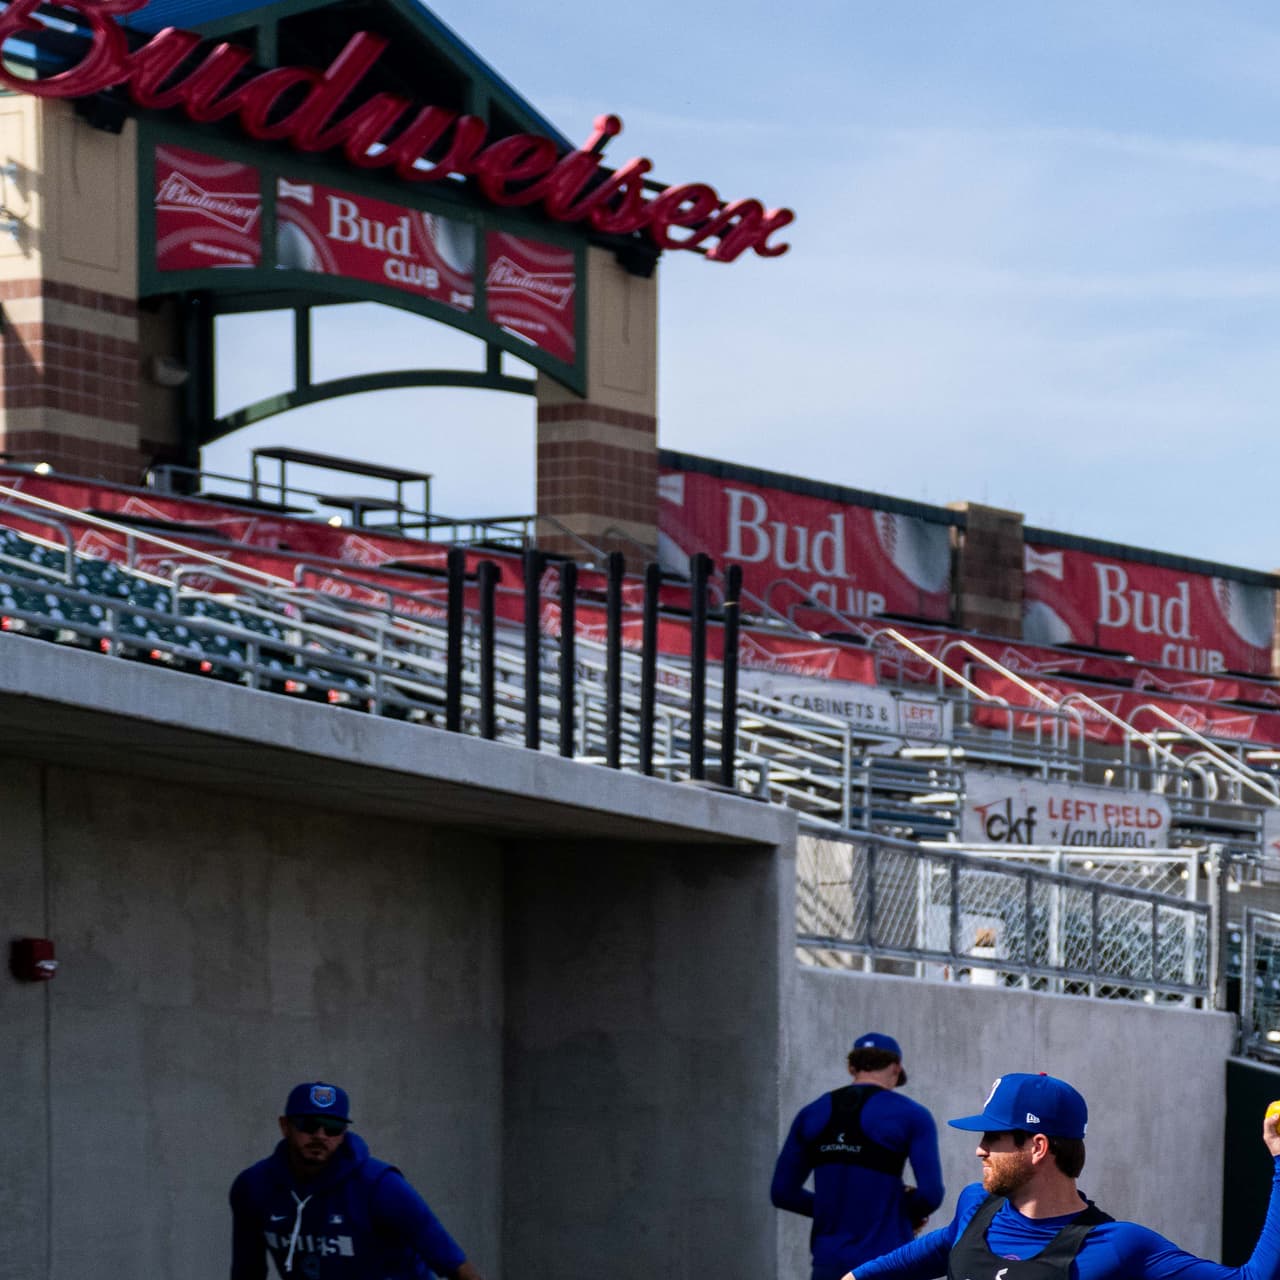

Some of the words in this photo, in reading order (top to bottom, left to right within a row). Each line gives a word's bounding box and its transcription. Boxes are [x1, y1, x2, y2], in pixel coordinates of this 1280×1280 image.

[0, 0, 794, 262] Budweiser
[328, 194, 411, 258] Bud
[383, 257, 440, 290] CLUB
[722, 487, 851, 579] Bud
[1093, 562, 1192, 640] Bud
[985, 799, 1037, 845] ckf
[1048, 797, 1098, 823] LEFT
[1103, 803, 1162, 830] FIELD
